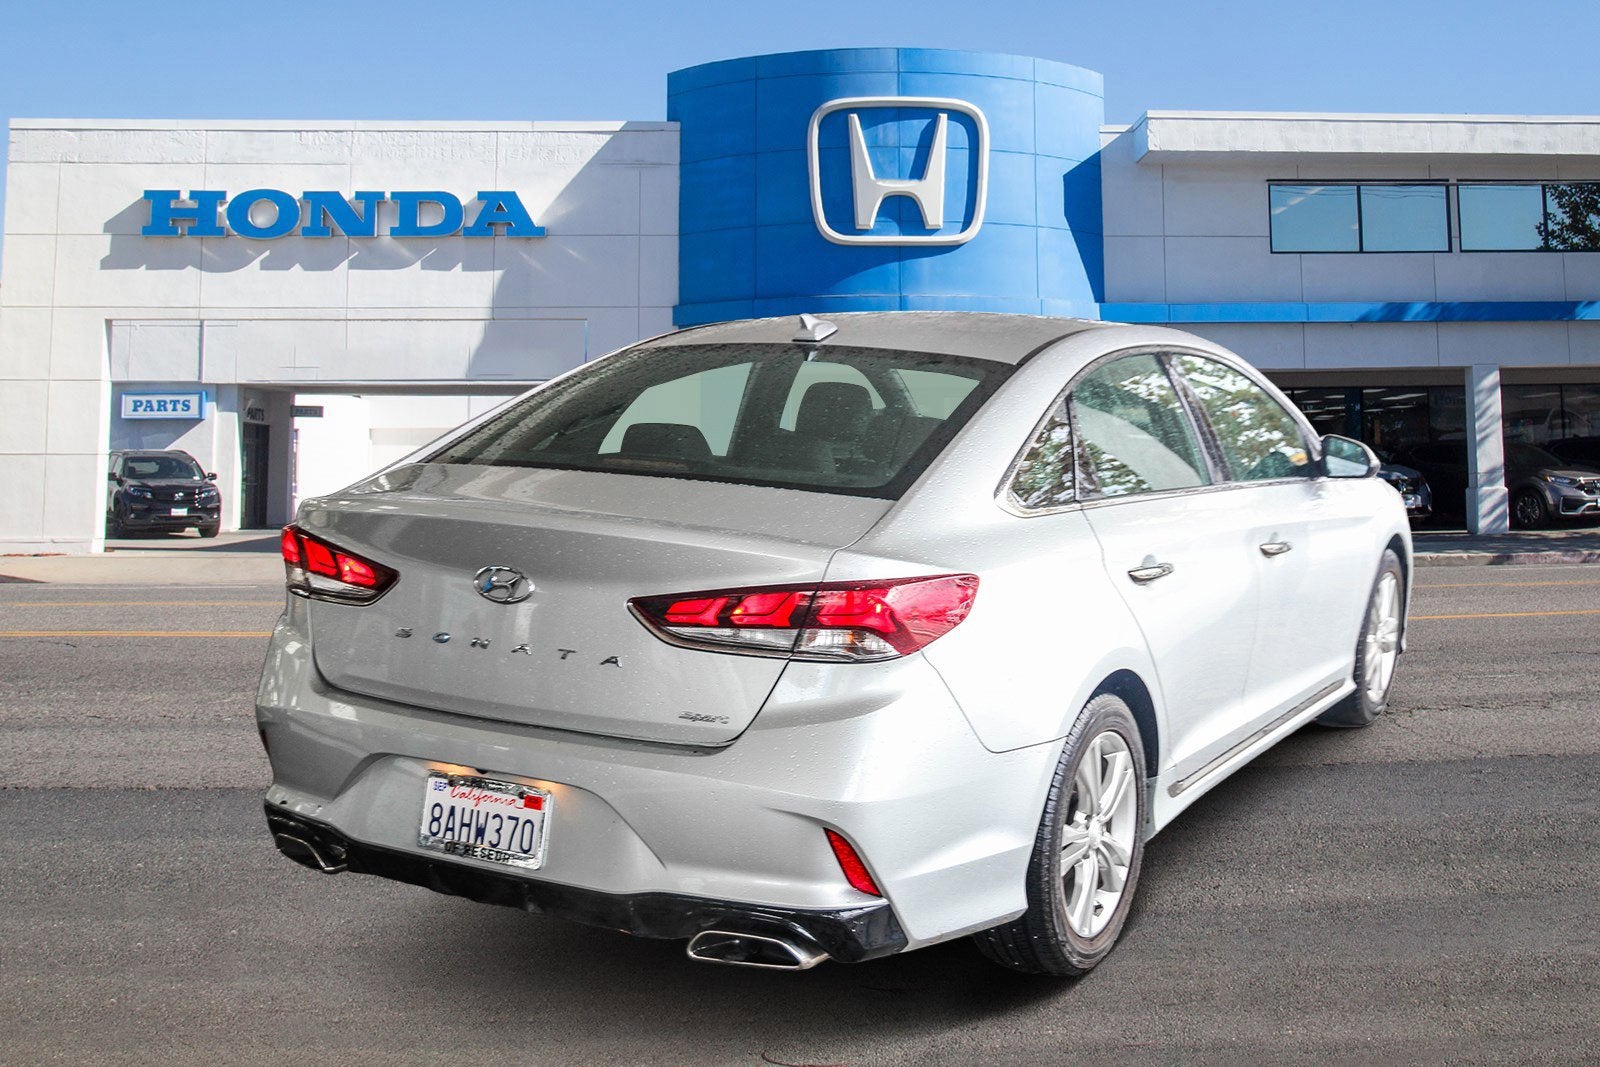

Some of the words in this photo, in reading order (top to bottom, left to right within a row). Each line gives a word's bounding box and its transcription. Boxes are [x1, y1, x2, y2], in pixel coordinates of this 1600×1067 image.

[141, 188, 547, 239] HONDA
[132, 399, 191, 412] PARTS
[395, 627, 622, 669] SONATA
[450, 784, 525, 809] California
[429, 802, 535, 854] 8AHW370
